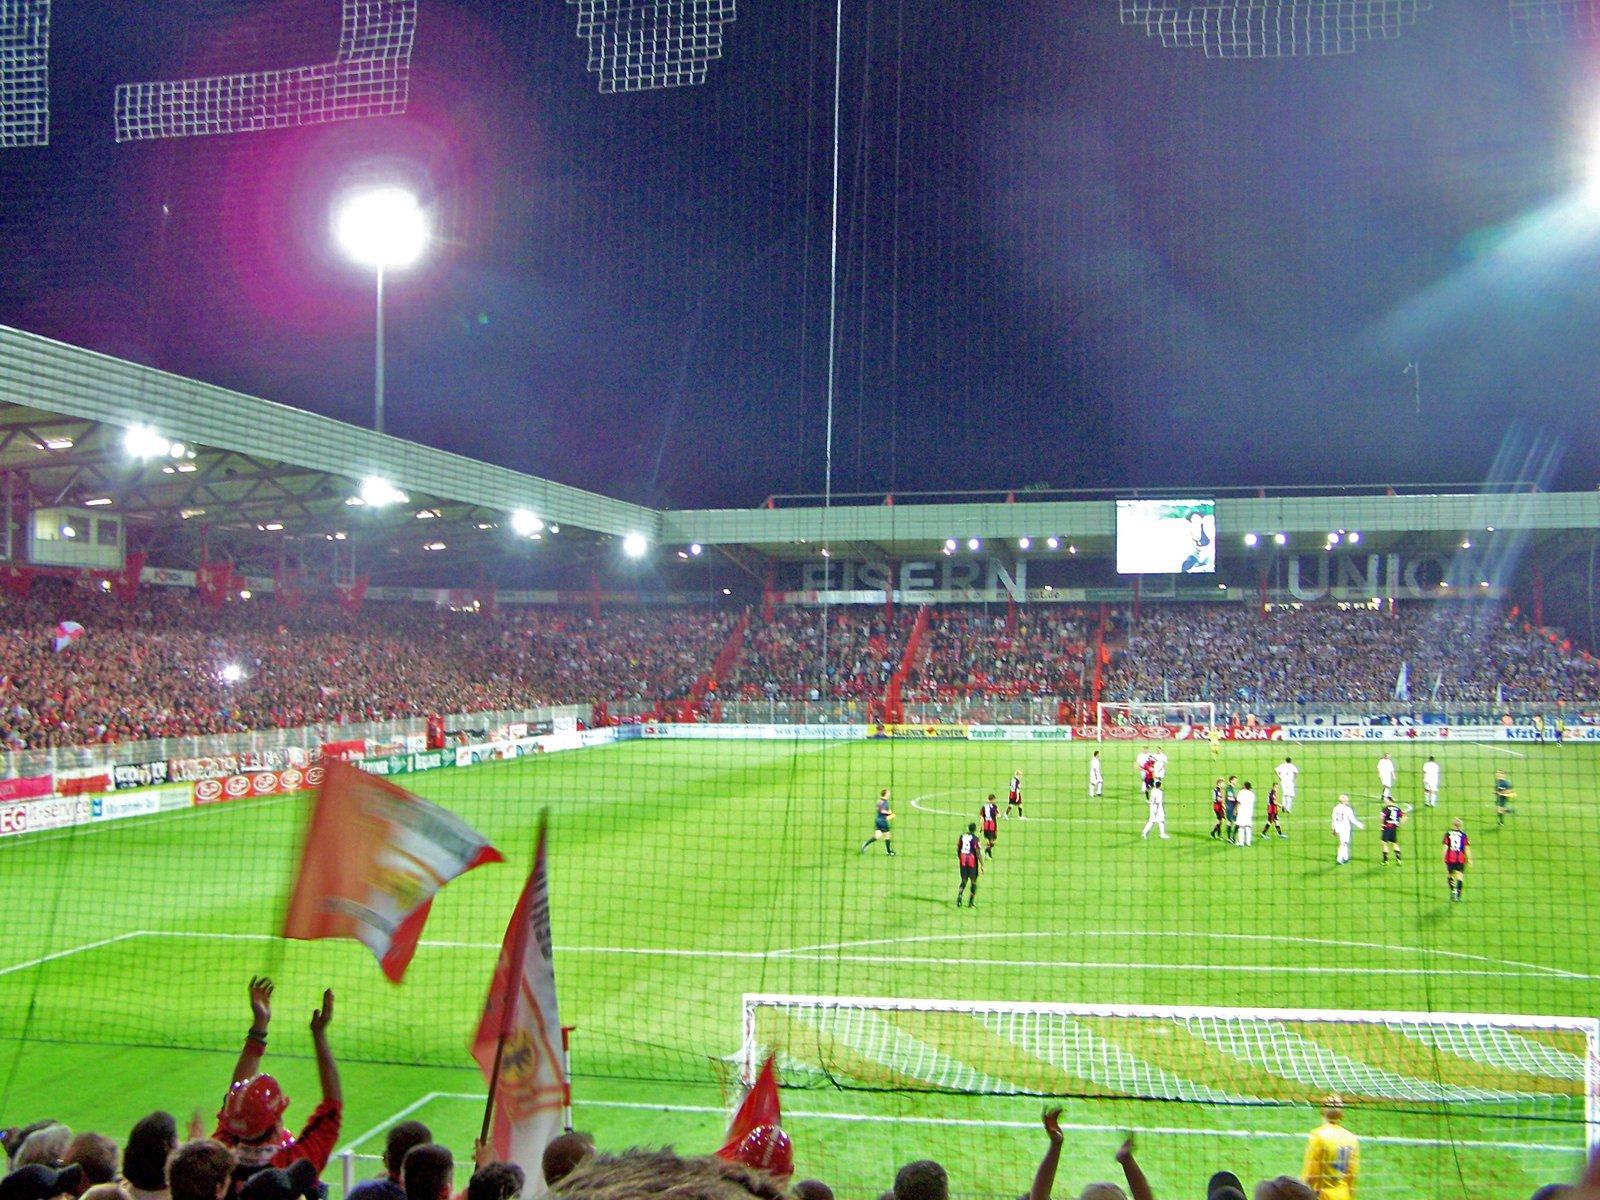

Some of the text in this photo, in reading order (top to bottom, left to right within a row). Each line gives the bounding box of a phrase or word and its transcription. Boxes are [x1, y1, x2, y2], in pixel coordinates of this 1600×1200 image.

[802, 552, 1502, 604] EISERN UNION
[1289, 728, 1383, 739] kfzteile24.de
[1505, 728, 1600, 739] kfztil24.de
